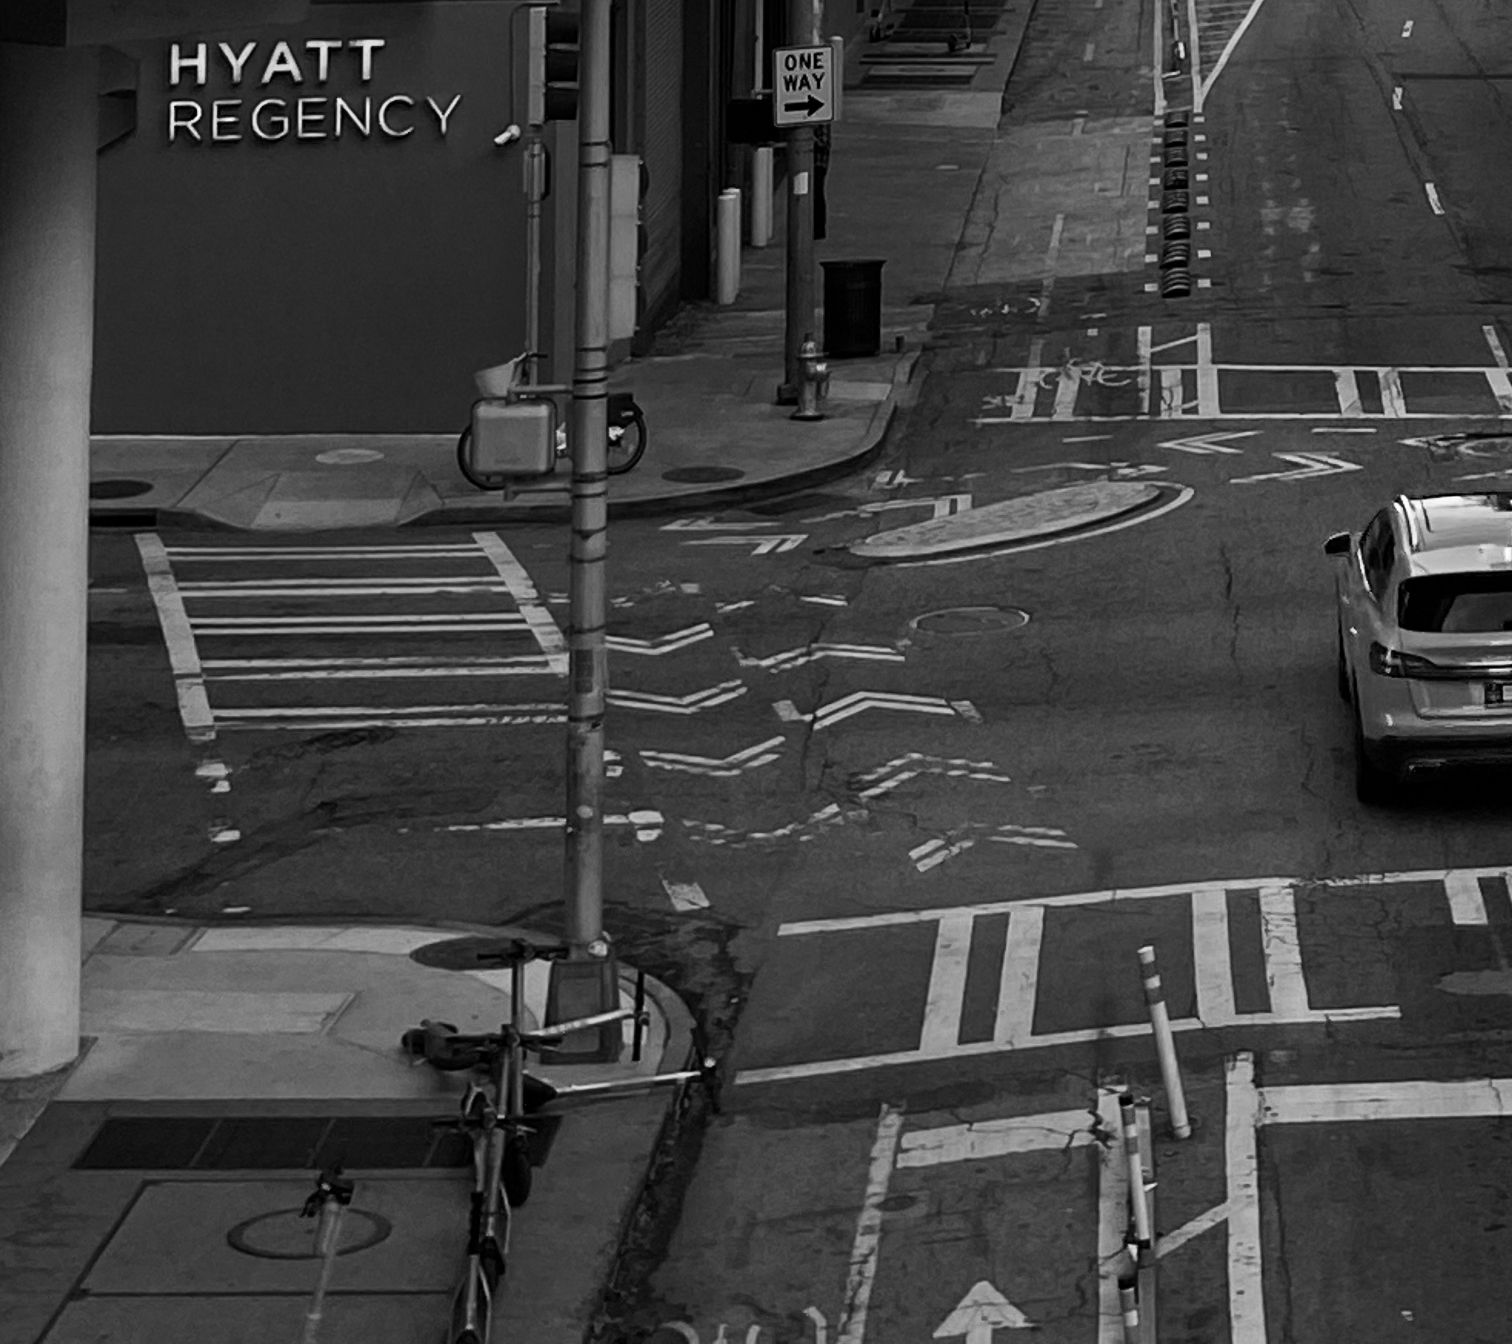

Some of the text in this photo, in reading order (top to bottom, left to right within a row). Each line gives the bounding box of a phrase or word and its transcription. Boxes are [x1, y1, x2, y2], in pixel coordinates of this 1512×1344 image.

[169, 38, 386, 85] HYATT
[784, 51, 825, 72] ONE
[782, 71, 826, 92] WAY
[168, 94, 462, 141] REGENCY
